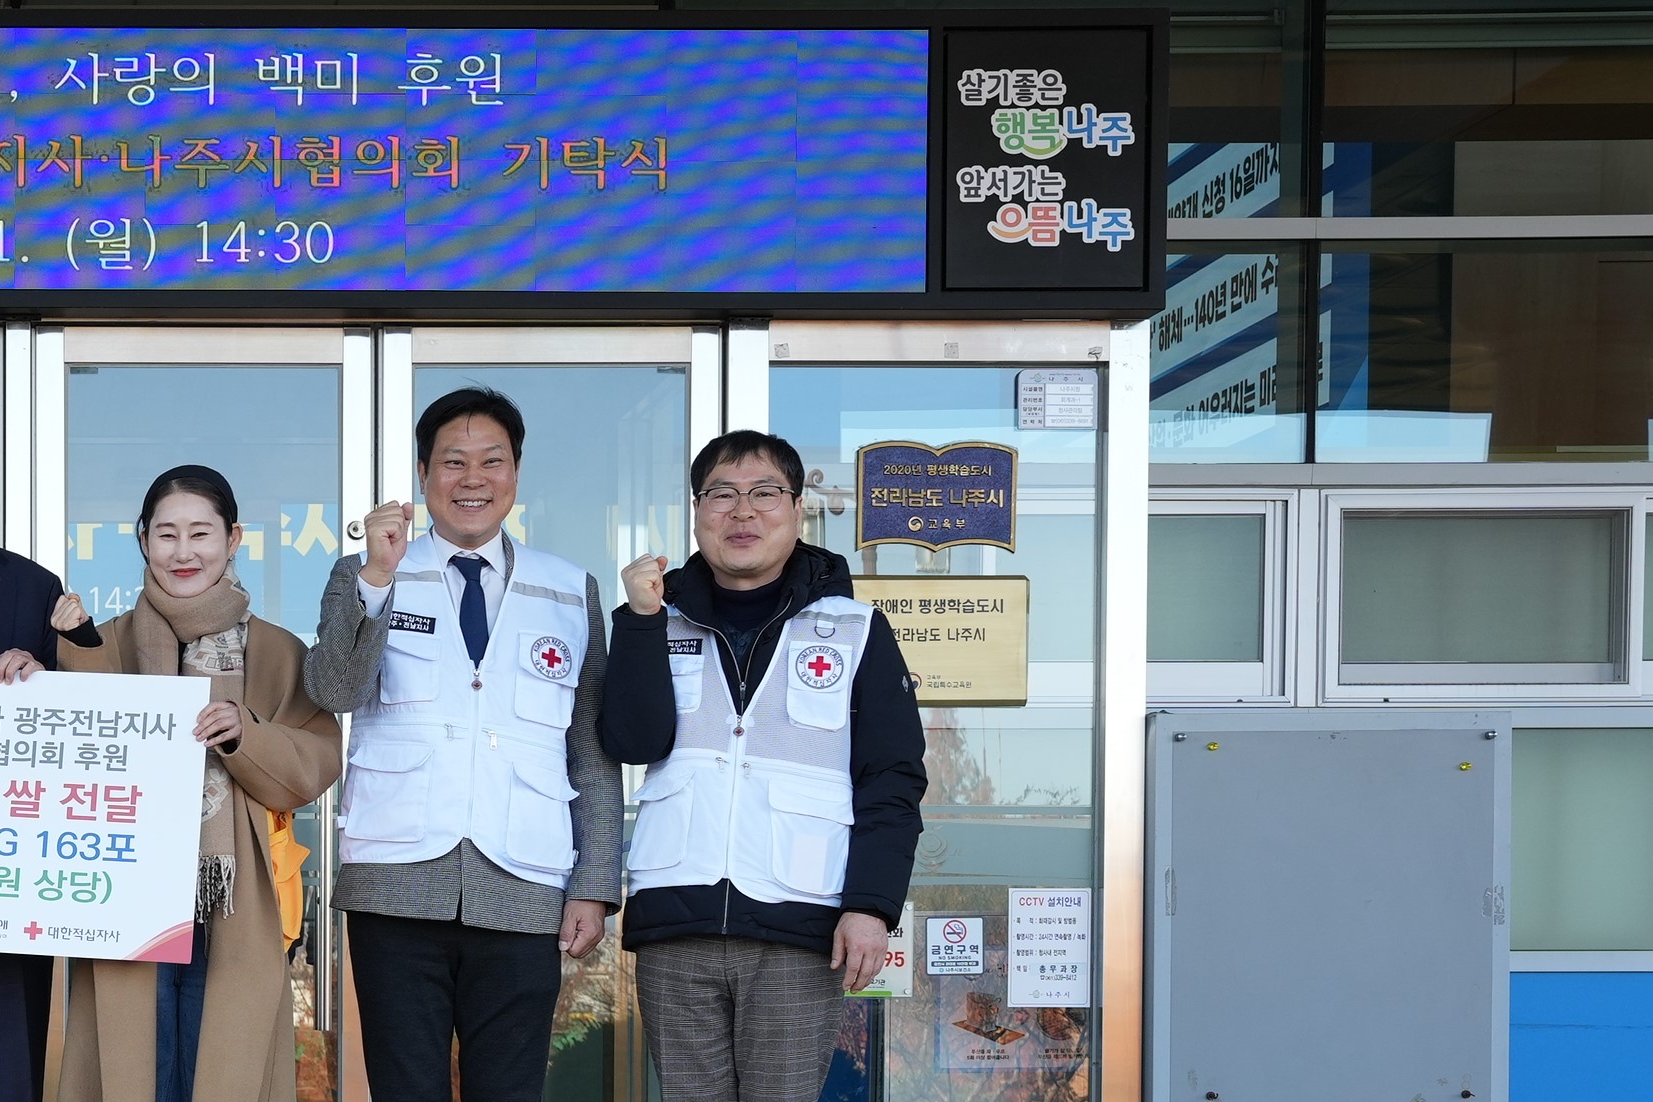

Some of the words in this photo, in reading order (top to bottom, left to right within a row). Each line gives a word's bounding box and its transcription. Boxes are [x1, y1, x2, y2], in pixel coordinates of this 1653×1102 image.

[54, 50, 215, 107] 사랑의
[255, 50, 358, 107] 백미
[396, 50, 504, 107] 후원
[957, 69, 1067, 106] 살기좋은
[506, 134, 668, 191] 기탁식
[956, 165, 1066, 202] 앞서가는
[1202, 172, 1226, 218] 신청
[66, 216, 158, 271] (월)
[194, 218, 335, 266] 14:30
[1231, 263, 1257, 314] 만에
[884, 464, 922, 476] 2020년
[927, 464, 992, 476] 평생학습도시
[870, 487, 943, 508] 전라남도
[950, 487, 1004, 509] 나주시
[928, 519, 966, 529] 교육부
[389, 611, 431, 625] 한적십자사
[918, 599, 1004, 614] 평생학습도시
[947, 628, 986, 642] 나주시
[13, 704, 176, 742] 광주전남지사
[74, 742, 129, 772] 후원
[3, 779, 47, 820] 쌀
[59, 783, 143, 824] 전달
[36, 830, 138, 863] 163포
[33, 869, 113, 905] 상당)
[1018, 897, 1045, 906] CCTV
[1047, 897, 1082, 907] 설치안내
[47, 926, 121, 943] 대한적십자사
[931, 944, 979, 955] 금연구역
